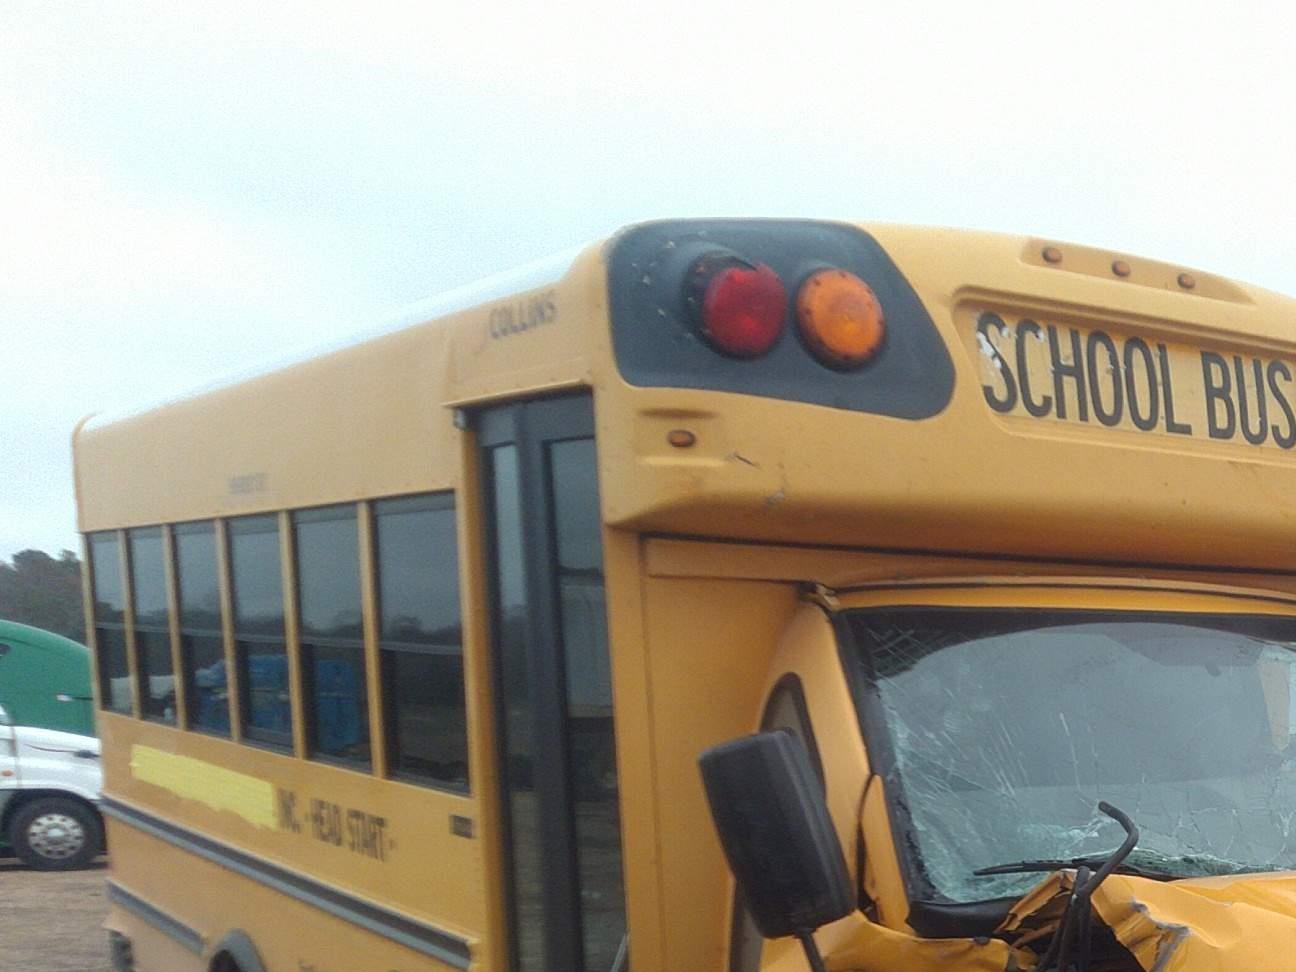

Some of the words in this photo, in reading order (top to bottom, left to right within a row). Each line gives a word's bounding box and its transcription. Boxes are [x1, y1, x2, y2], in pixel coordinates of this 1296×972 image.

[488, 297, 556, 338] COLLINS
[977, 311, 1193, 436] SCHOOL
[311, 798, 342, 847] HEAD
[346, 808, 386, 862] START
